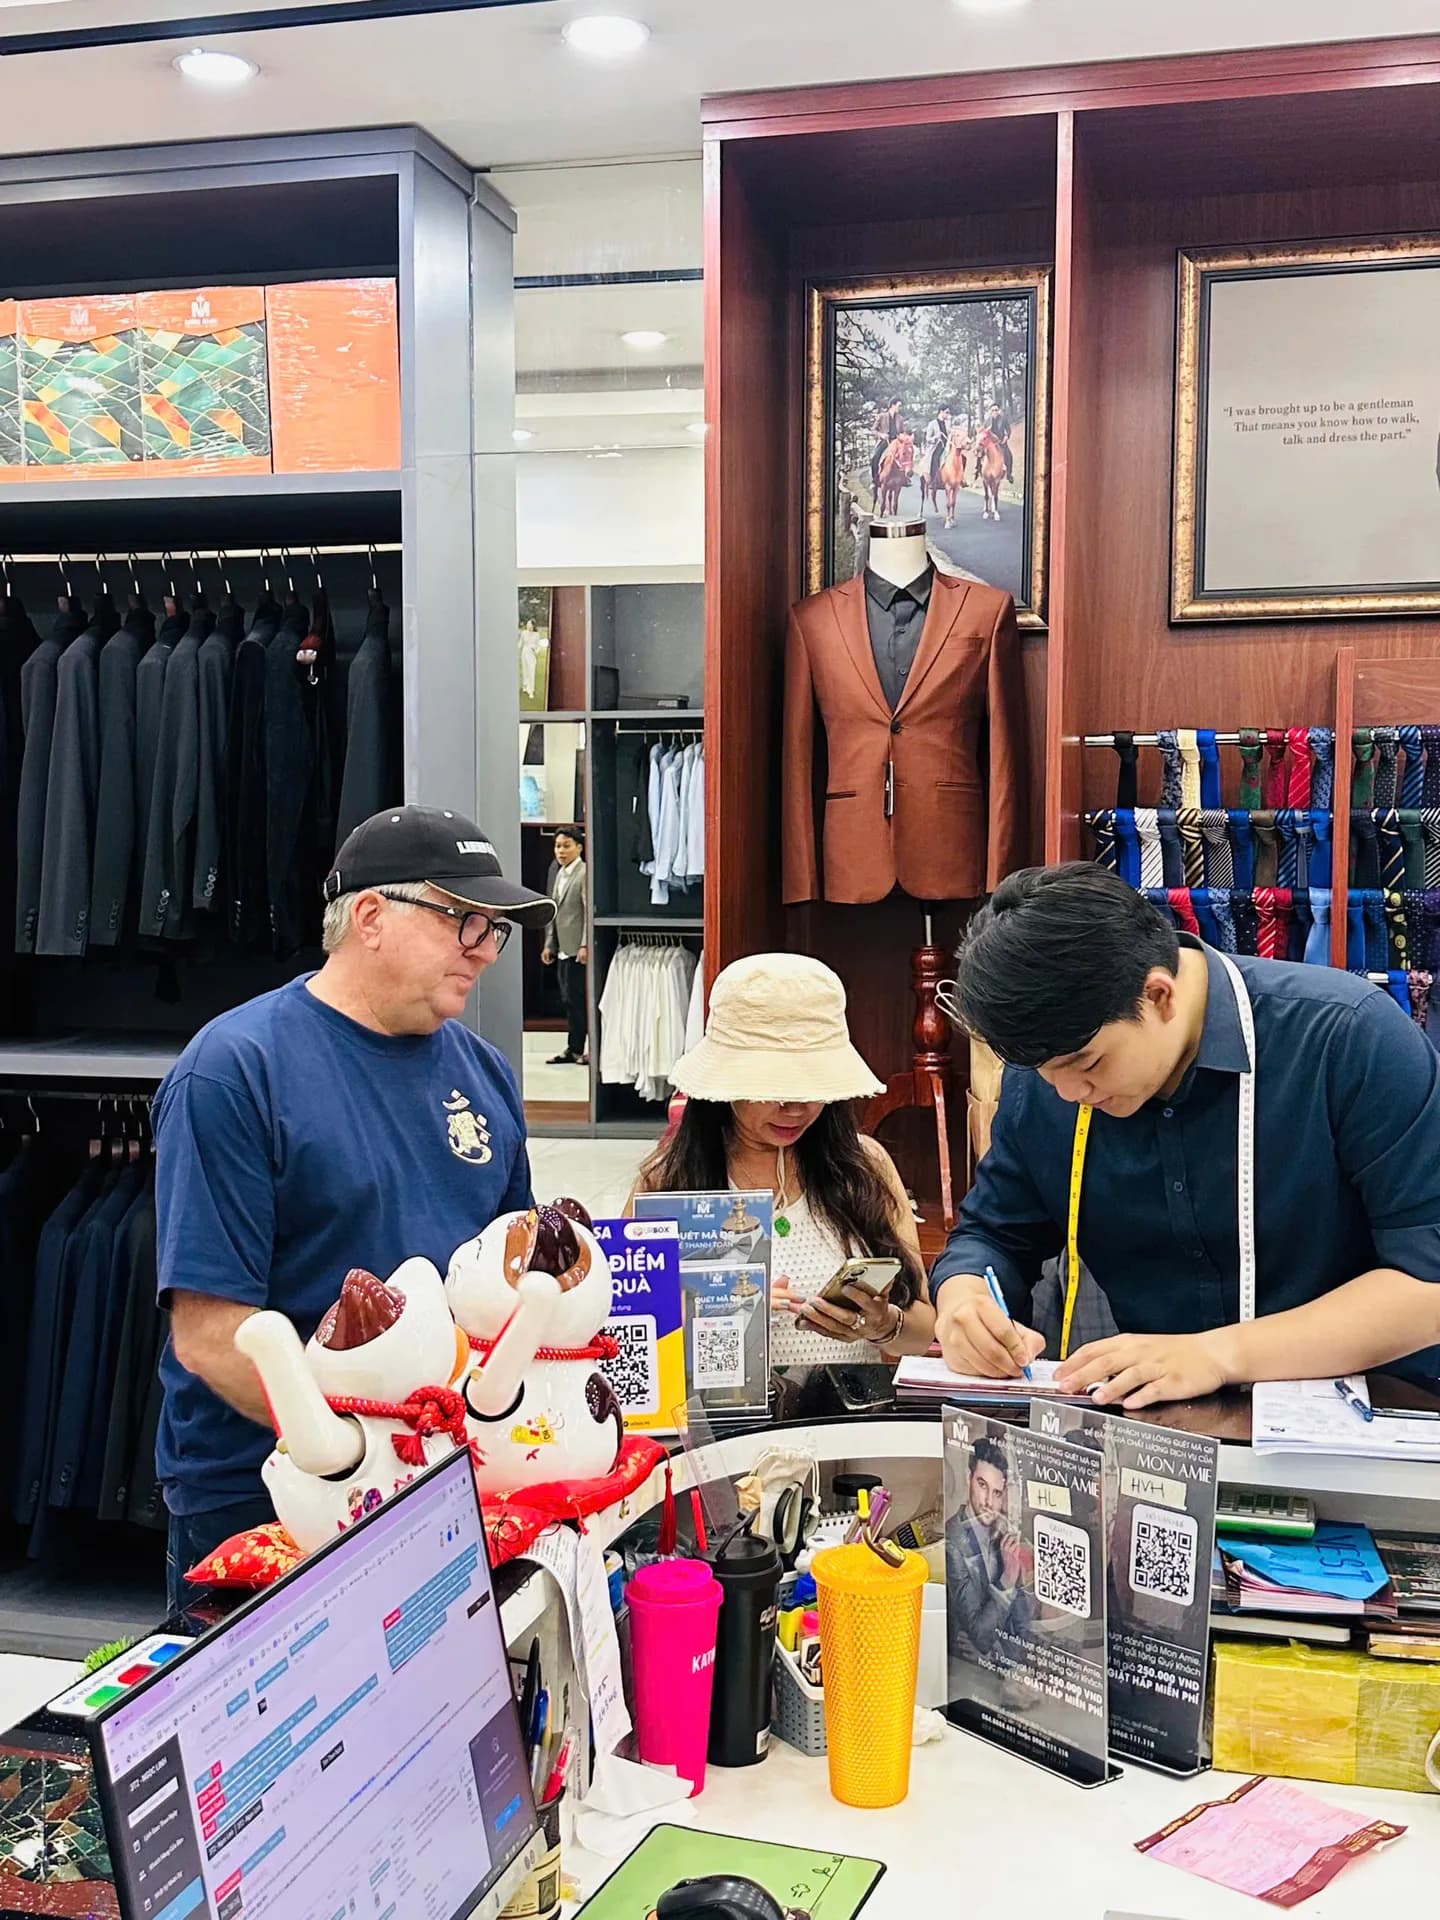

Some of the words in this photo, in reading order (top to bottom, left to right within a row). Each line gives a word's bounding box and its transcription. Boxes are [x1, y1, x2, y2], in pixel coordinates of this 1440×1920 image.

[1236, 408, 1256, 416] was
[1258, 404, 1300, 416] brought
[1303, 404, 1317, 414] up
[1320, 403, 1331, 412] to
[1333, 400, 1346, 411] be
[1348, 402, 1354, 411] a
[1357, 398, 1414, 412] gentleman
[1234, 422, 1258, 432] That
[1261, 421, 1295, 431] means
[1297, 420, 1317, 431] you
[1320, 417, 1348, 428] know
[1352, 415, 1373, 426] how
[1377, 416, 1388, 425] to
[1391, 413, 1420, 424] walk,
[1283, 434, 1303, 445] talk
[1306, 433, 1326, 444] and
[1329, 432, 1357, 443] dress
[1360, 431, 1378, 441] the
[1136, 1453, 1176, 1474] MON
[1178, 1464, 1212, 1484] AMIE
[1034, 1464, 1069, 1486] MON
[1070, 1475, 1099, 1497] AMIE
[1131, 1478, 1165, 1497] HVH
[1037, 1488, 1057, 1507] HL
[1315, 1535, 1374, 1583] VEST
[1159, 1645, 1178, 1659] Mon
[1136, 1665, 1176, 1684] 250.000
[1178, 1676, 1200, 1691] VND
[1176, 1661, 1201, 1677] Khách
[1048, 1674, 1083, 1695] 250.000
[1083, 1687, 1103, 1705] VND
[1182, 1692, 1199, 1705] PHÍ
